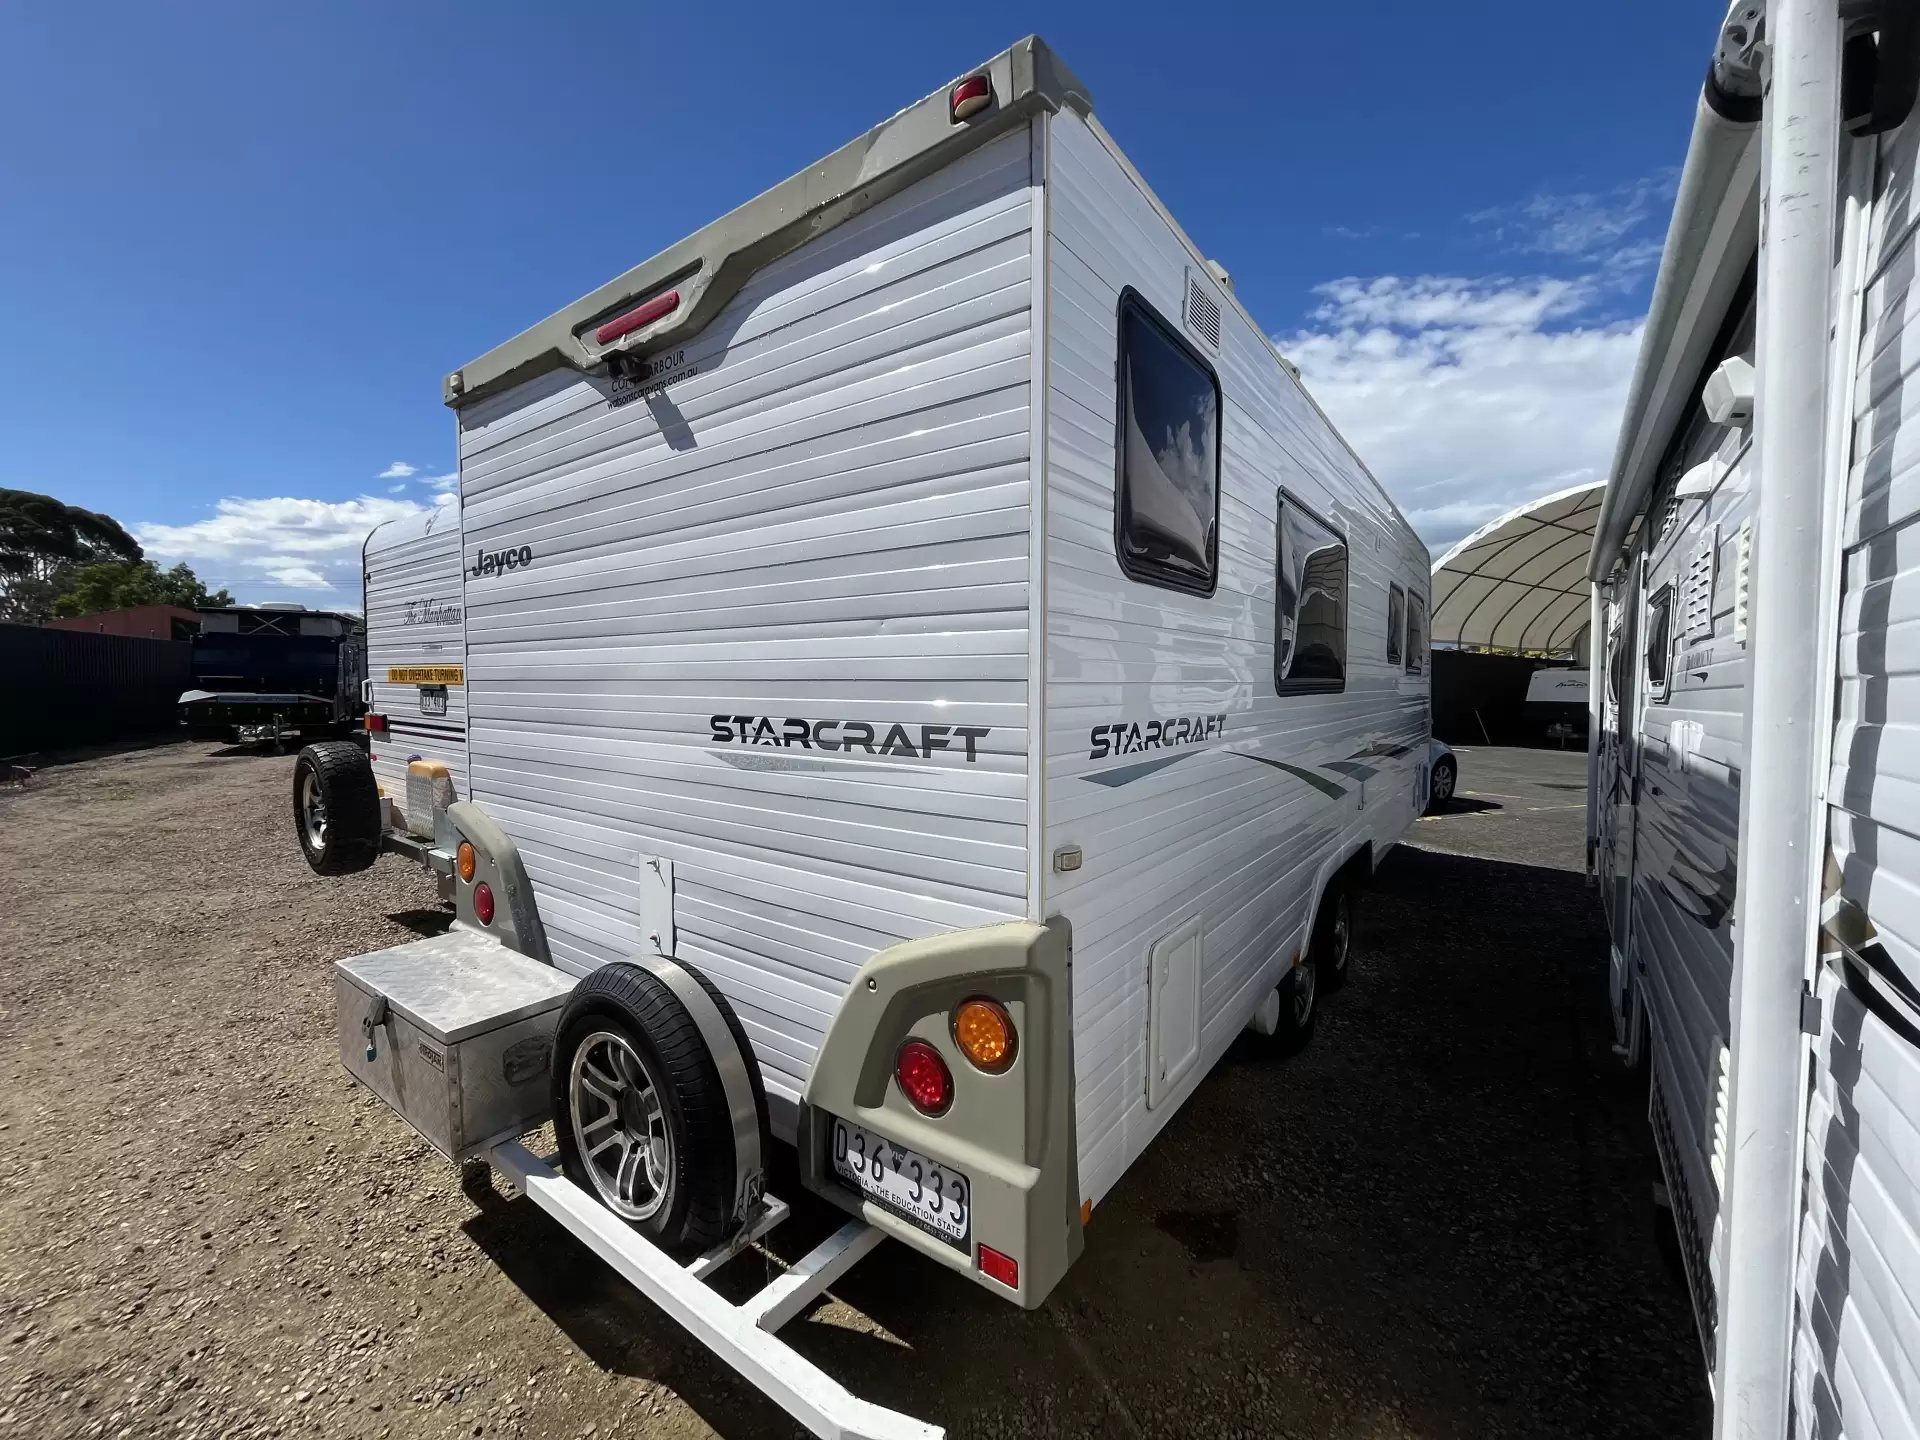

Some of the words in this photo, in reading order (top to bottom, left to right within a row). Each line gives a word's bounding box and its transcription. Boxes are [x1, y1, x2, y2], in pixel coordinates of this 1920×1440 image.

[649, 350, 685, 377] ARBOUR
[471, 545, 532, 578] Jayco
[710, 714, 992, 763] STARCRAFT
[1089, 714, 1227, 761] STARCRAFT
[836, 1123, 885, 1183] D36
[908, 1159, 966, 1226] 333
[837, 1163, 869, 1189] VICTORIA
[875, 1184, 890, 1200] THE
[891, 1193, 936, 1223] EDUCATION
[937, 1215, 962, 1238] STATE
